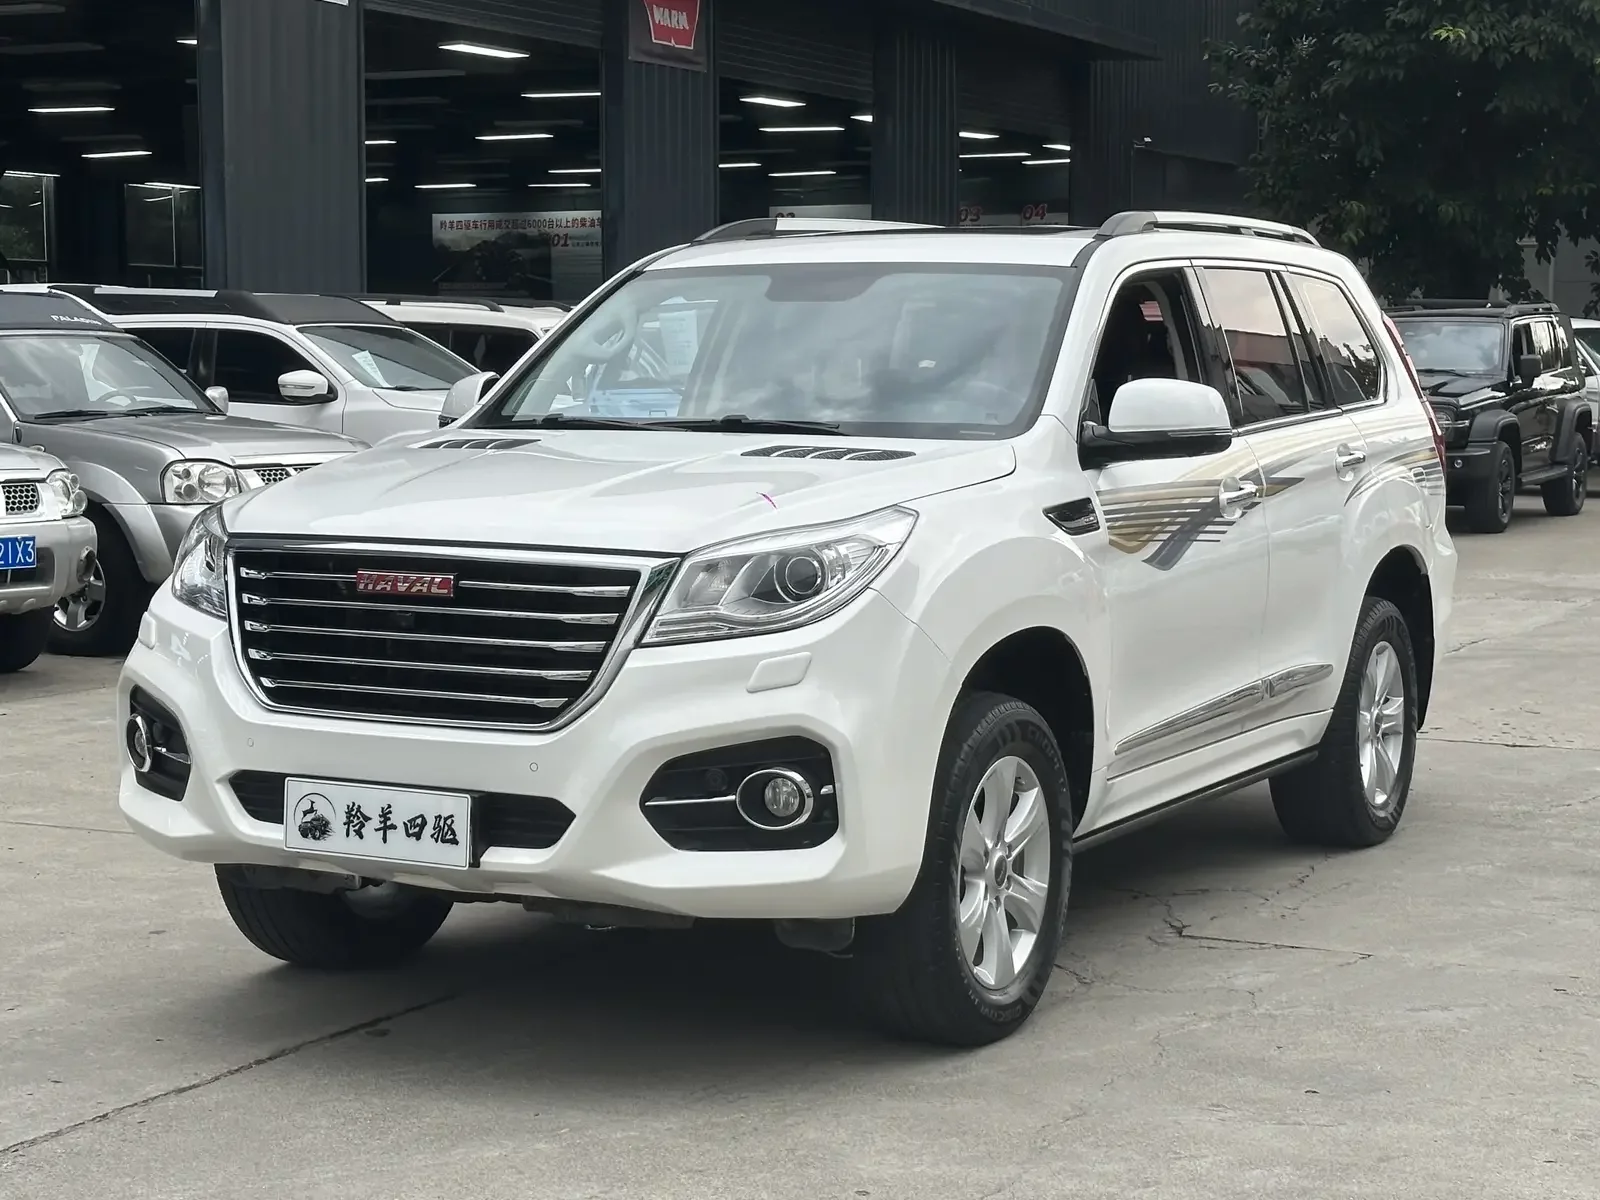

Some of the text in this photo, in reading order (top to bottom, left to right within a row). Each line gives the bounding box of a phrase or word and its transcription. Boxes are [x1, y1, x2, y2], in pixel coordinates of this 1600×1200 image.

[652, 4, 689, 30] WARN
[1021, 203, 1047, 221] 04
[551, 232, 570, 248] 01
[358, 574, 449, 594] HAVAL
[342, 801, 460, 846] 羚羊四驱
